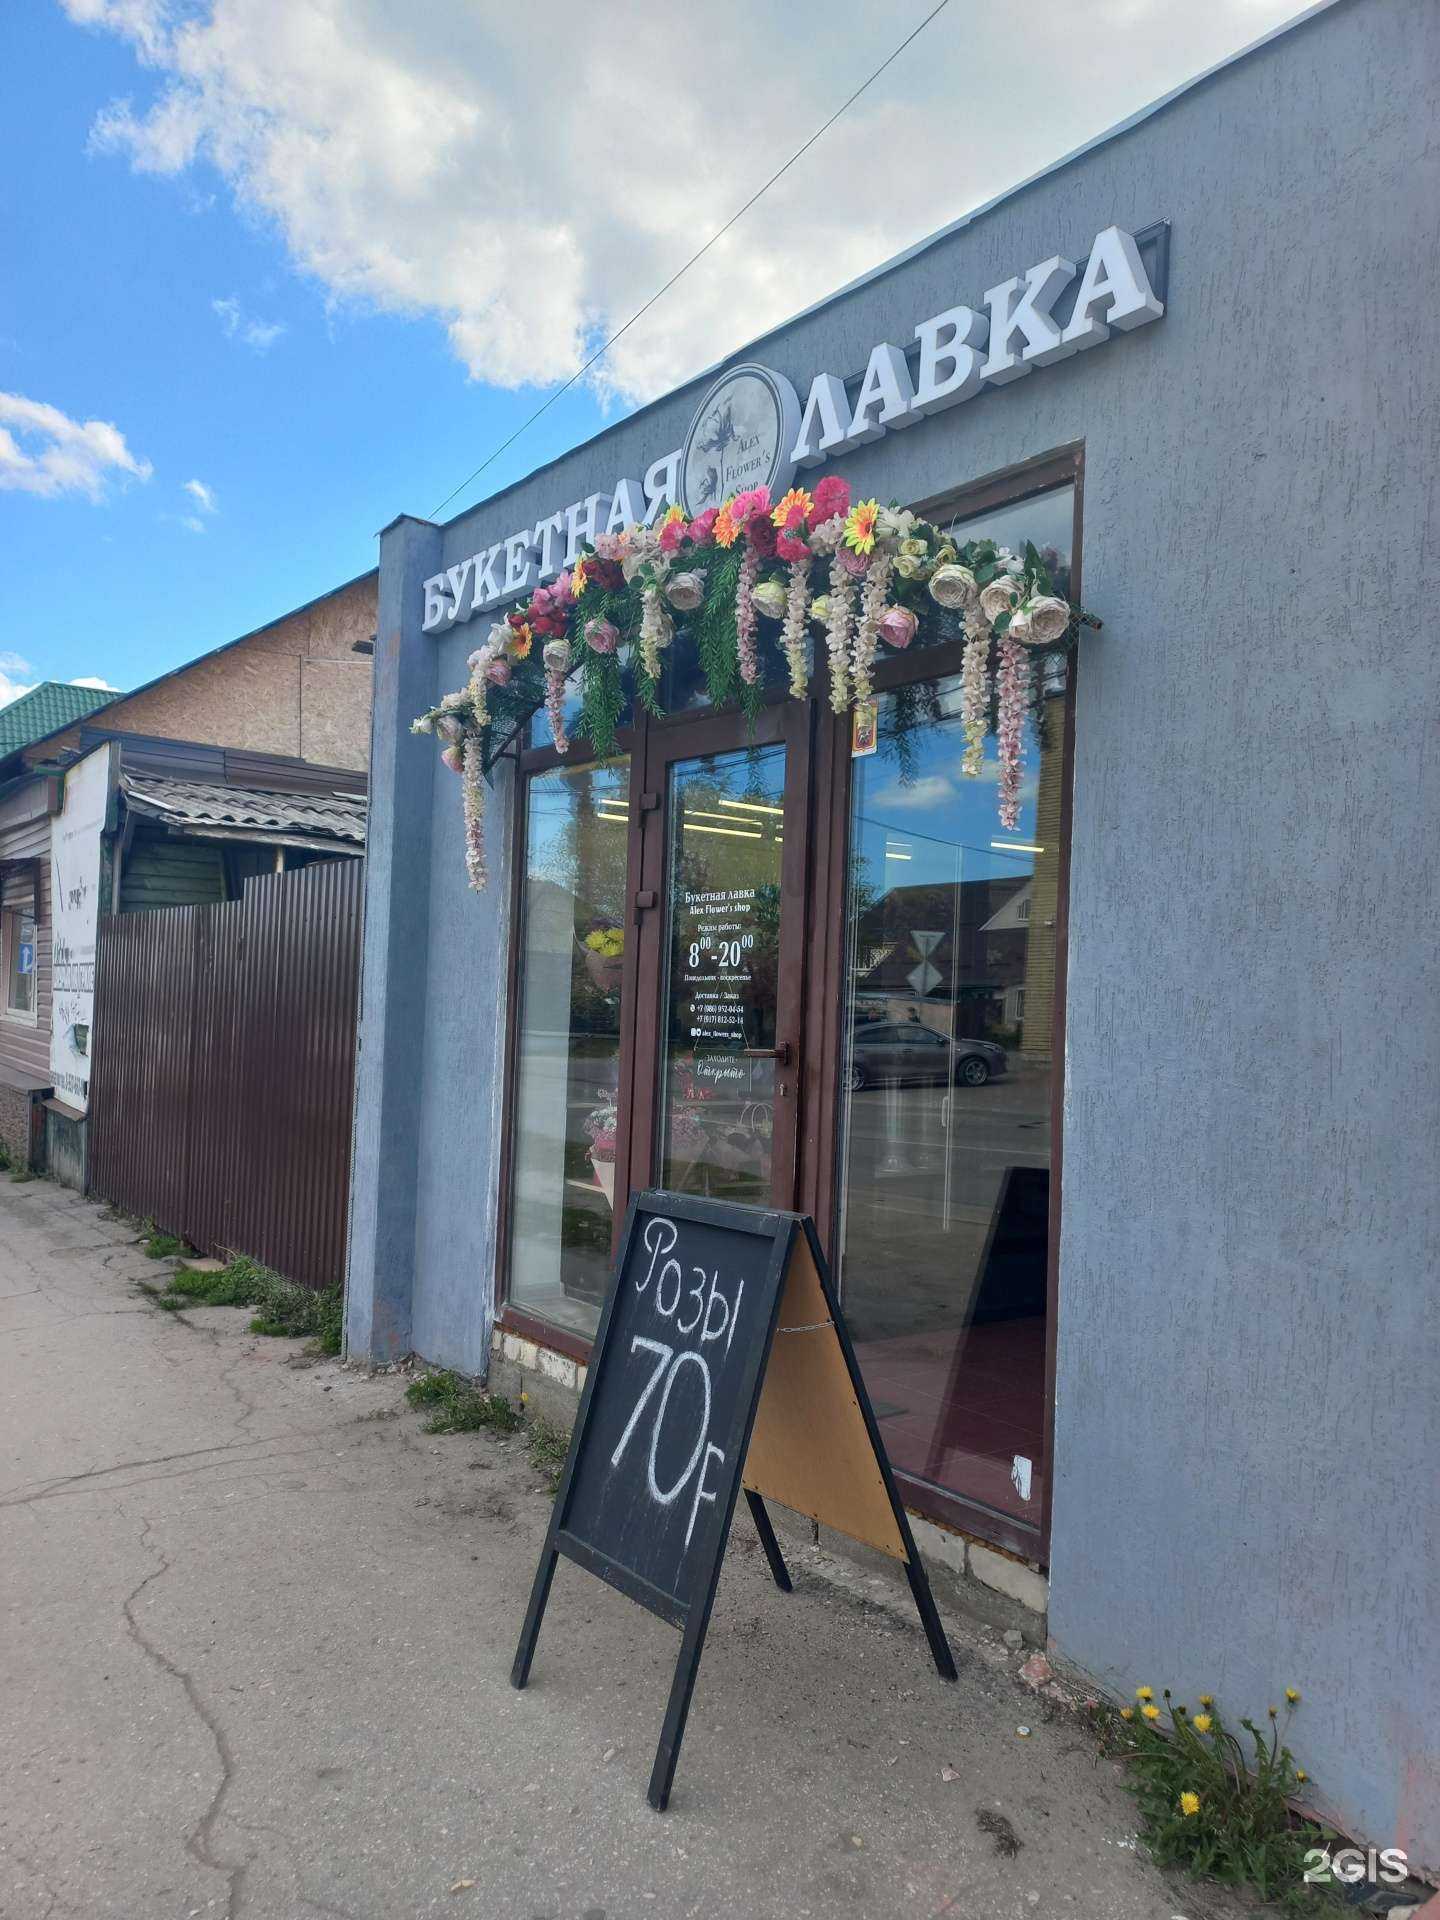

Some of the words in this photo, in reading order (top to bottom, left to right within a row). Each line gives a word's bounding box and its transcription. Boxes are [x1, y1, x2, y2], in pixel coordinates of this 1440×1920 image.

[422, 449, 682, 633] БУКЕТНАЯ
[790, 225, 1164, 466] ЛАВКА
[685, 891, 726, 905] Букетная
[728, 888, 755, 900] лавка
[689, 905, 704, 915] Alex
[705, 903, 733, 914] Flower's
[734, 902, 751, 912] shop
[635, 1217, 744, 1353] Розы
